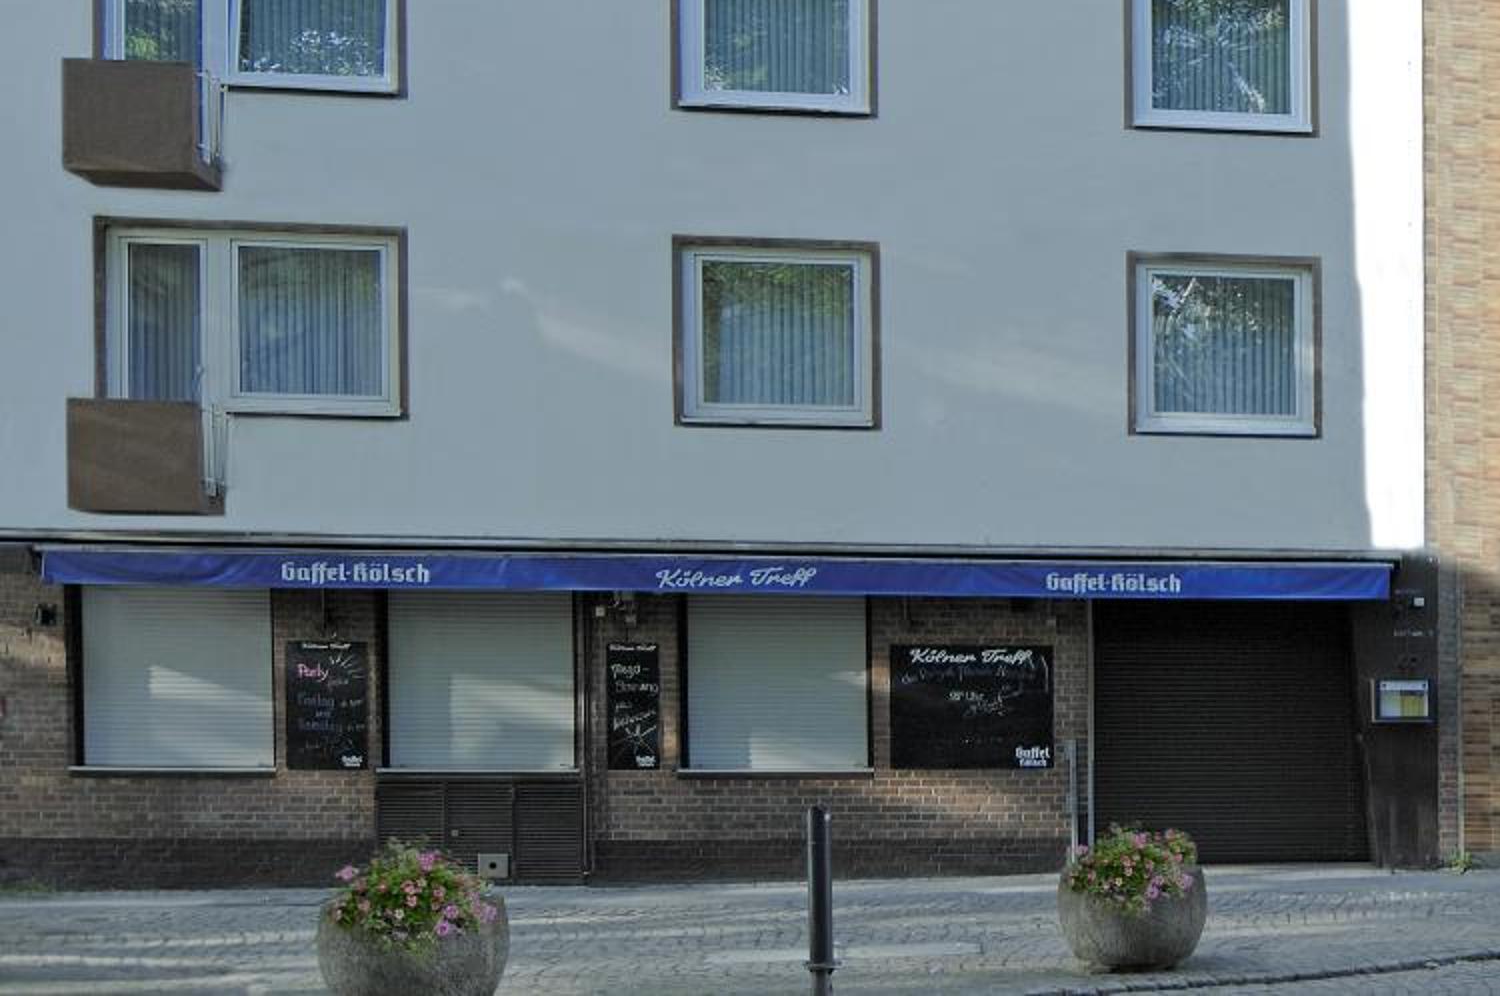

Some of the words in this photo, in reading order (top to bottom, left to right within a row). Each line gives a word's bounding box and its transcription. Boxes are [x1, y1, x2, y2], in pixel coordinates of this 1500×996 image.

[656, 567, 744, 589] Kölner
[749, 566, 817, 587] Treff
[909, 647, 977, 664] Kölner
[981, 648, 1033, 665] Treff
